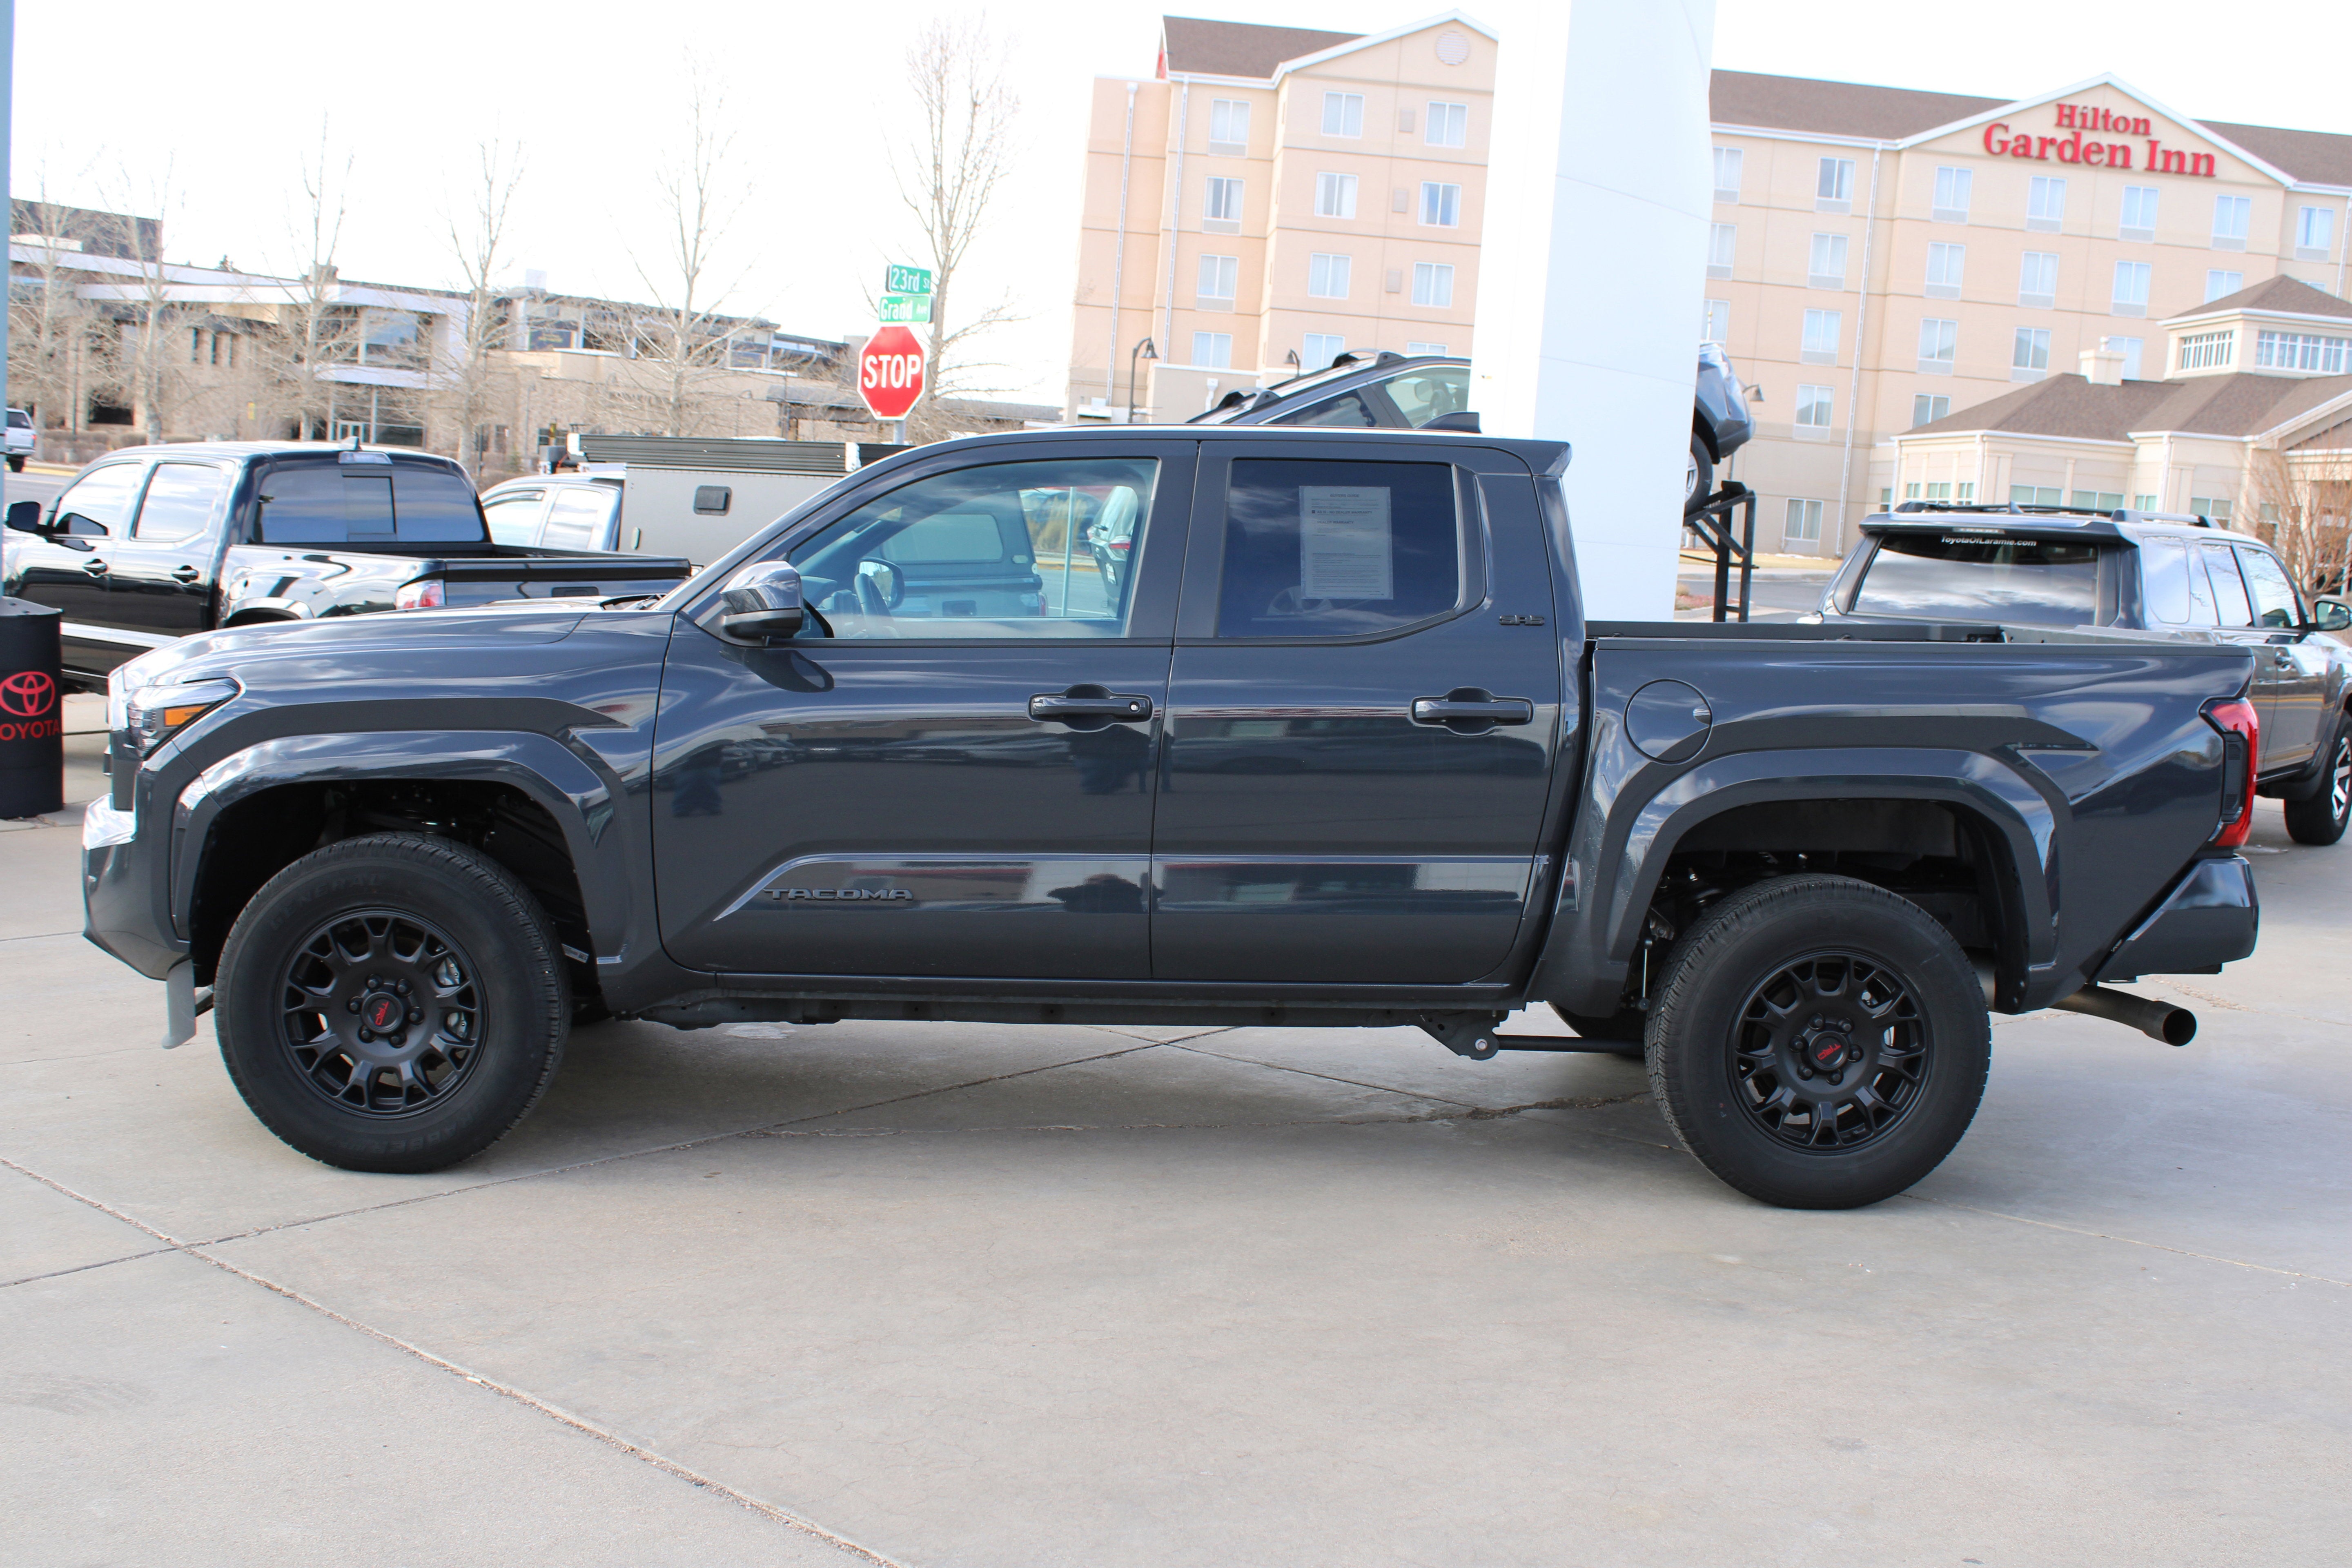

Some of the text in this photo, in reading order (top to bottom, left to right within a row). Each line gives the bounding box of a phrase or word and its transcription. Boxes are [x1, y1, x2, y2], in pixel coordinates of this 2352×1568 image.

[2056, 103, 2152, 136] Hilton
[1984, 123, 2216, 177] Garden Inn
[892, 267, 930, 292] 23rd St
[880, 298, 928, 321] Grand Ave
[863, 354, 921, 389] STOP
[1941, 536, 2037, 547] ToyotaOfLaramie.com
[0, 719, 60, 741] OYOTA
[763, 888, 914, 901] TACOMA
